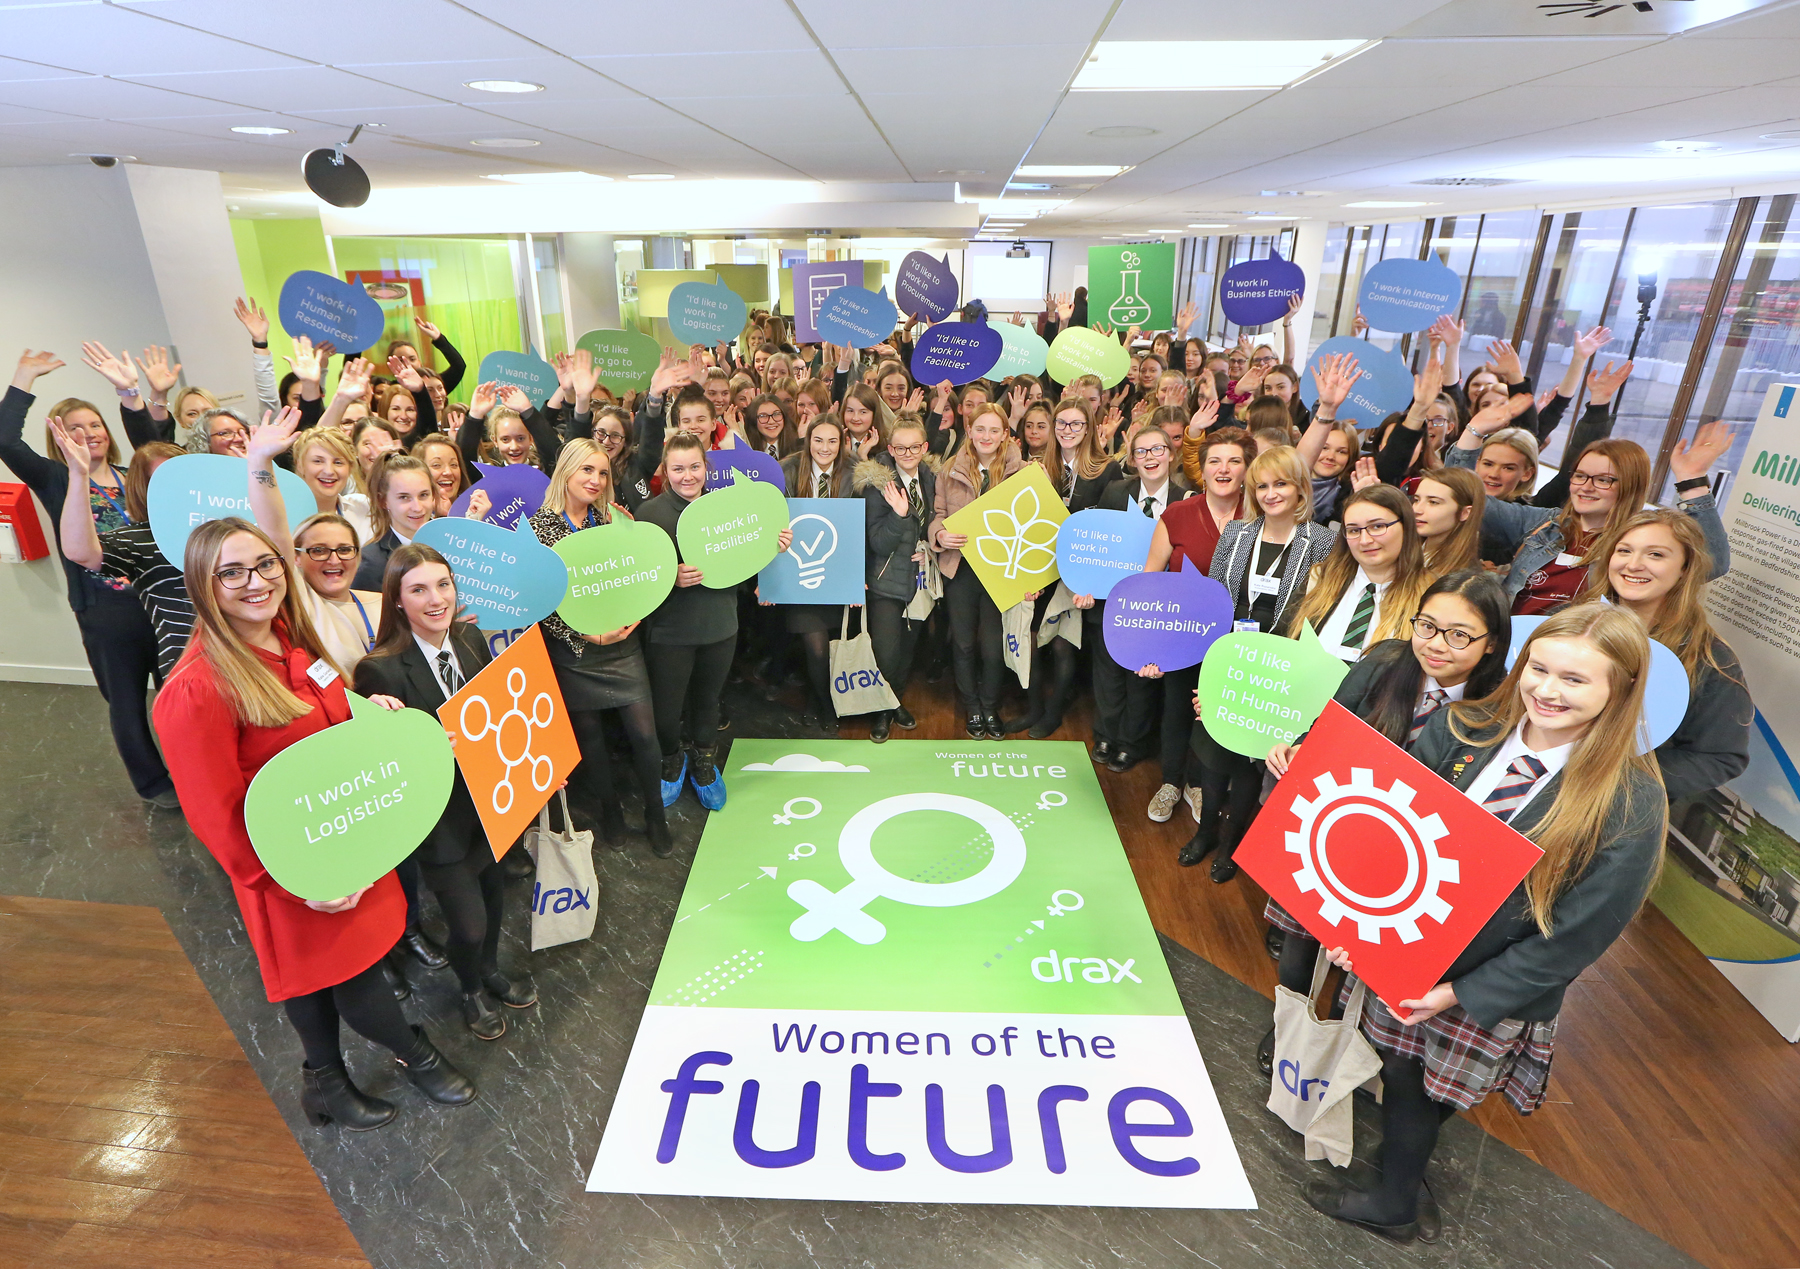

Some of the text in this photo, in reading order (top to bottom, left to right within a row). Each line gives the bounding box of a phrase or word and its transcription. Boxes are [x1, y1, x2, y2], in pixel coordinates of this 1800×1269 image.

[906, 270, 928, 290] work in
[912, 259, 940, 285] "I'd like to
[1236, 279, 1258, 287] work
[307, 286, 358, 316] "I work in
[686, 294, 728, 310] "I'd like to
[901, 280, 945, 314] Procurement"
[1227, 288, 1300, 298] Business Ethics"
[1368, 292, 1445, 312] Communications"
[1380, 285, 1401, 293] work
[1403, 287, 1411, 295] in
[1413, 289, 1449, 302] Internal
[300, 299, 341, 323] Human
[684, 309, 716, 319] work in
[848, 301, 860, 310] like
[295, 311, 358, 343] Resources"
[683, 317, 724, 332] Logistics"
[826, 313, 879, 338] Apprenticeship"
[594, 344, 628, 354] "I'd like
[930, 346, 964, 357] work in
[936, 334, 980, 348] "I'd like to
[1020, 348, 1030, 356] to
[1081, 340, 1095, 352] like
[1095, 349, 1105, 357] to
[594, 356, 632, 367] to go to
[924, 356, 970, 370] Facilities"
[1007, 354, 1016, 363] in
[1062, 344, 1090, 361] work in
[505, 368, 528, 379] want
[530, 372, 539, 382] to
[602, 369, 646, 380] niversity"
[1362, 370, 1373, 380] to
[532, 387, 543, 395] an
[1353, 394, 1386, 415] Ethics"
[747, 469, 759, 478] to
[190, 490, 252, 510] "I work
[496, 497, 526, 520] work
[701, 514, 758, 537] "I work in
[1073, 528, 1122, 543] "I'd like to
[1731, 528, 1757, 541] response
[1734, 518, 1761, 532] Millbrook
[1761, 528, 1781, 540] Power
[444, 532, 516, 564] "I'd like to
[705, 527, 763, 555] Facilities"
[1071, 543, 1108, 554] work in
[1728, 536, 1745, 547] South
[1755, 548, 1769, 556] near
[1770, 553, 1780, 561] the
[439, 551, 493, 575] work in
[1069, 554, 1143, 572] Communicatio
[1730, 546, 1753, 561] oretaine
[567, 555, 635, 578] "I work in
[453, 573, 519, 600] mmunity
[572, 565, 661, 598] Engineering"
[1729, 568, 1775, 591] project received
[458, 592, 529, 616] agement"
[1118, 598, 1180, 613] "I work in
[1710, 588, 1777, 624] average does not exceed
[1735, 590, 1751, 602] hours
[1758, 601, 1770, 611] any
[1770, 607, 1787, 618] given
[1746, 584, 1794, 610] Millbrook Power
[1113, 615, 1216, 637] Sustainability"
[1707, 596, 1726, 610] sources
[1763, 624, 1792, 643] including
[1713, 610, 1792, 654] carbon technologies such as
[1234, 644, 1291, 672] "I'd like
[834, 670, 883, 694] drax
[1227, 665, 1291, 695] to work
[1222, 685, 1302, 722] in Human
[1216, 706, 1301, 742] Resource
[951, 761, 1066, 778] future
[295, 761, 400, 812] "I work in
[304, 781, 407, 844] Logistics"
[1031, 949, 1142, 984] drax
[772, 1023, 1116, 1059] Women of the
[655, 1051, 1201, 1177] future
